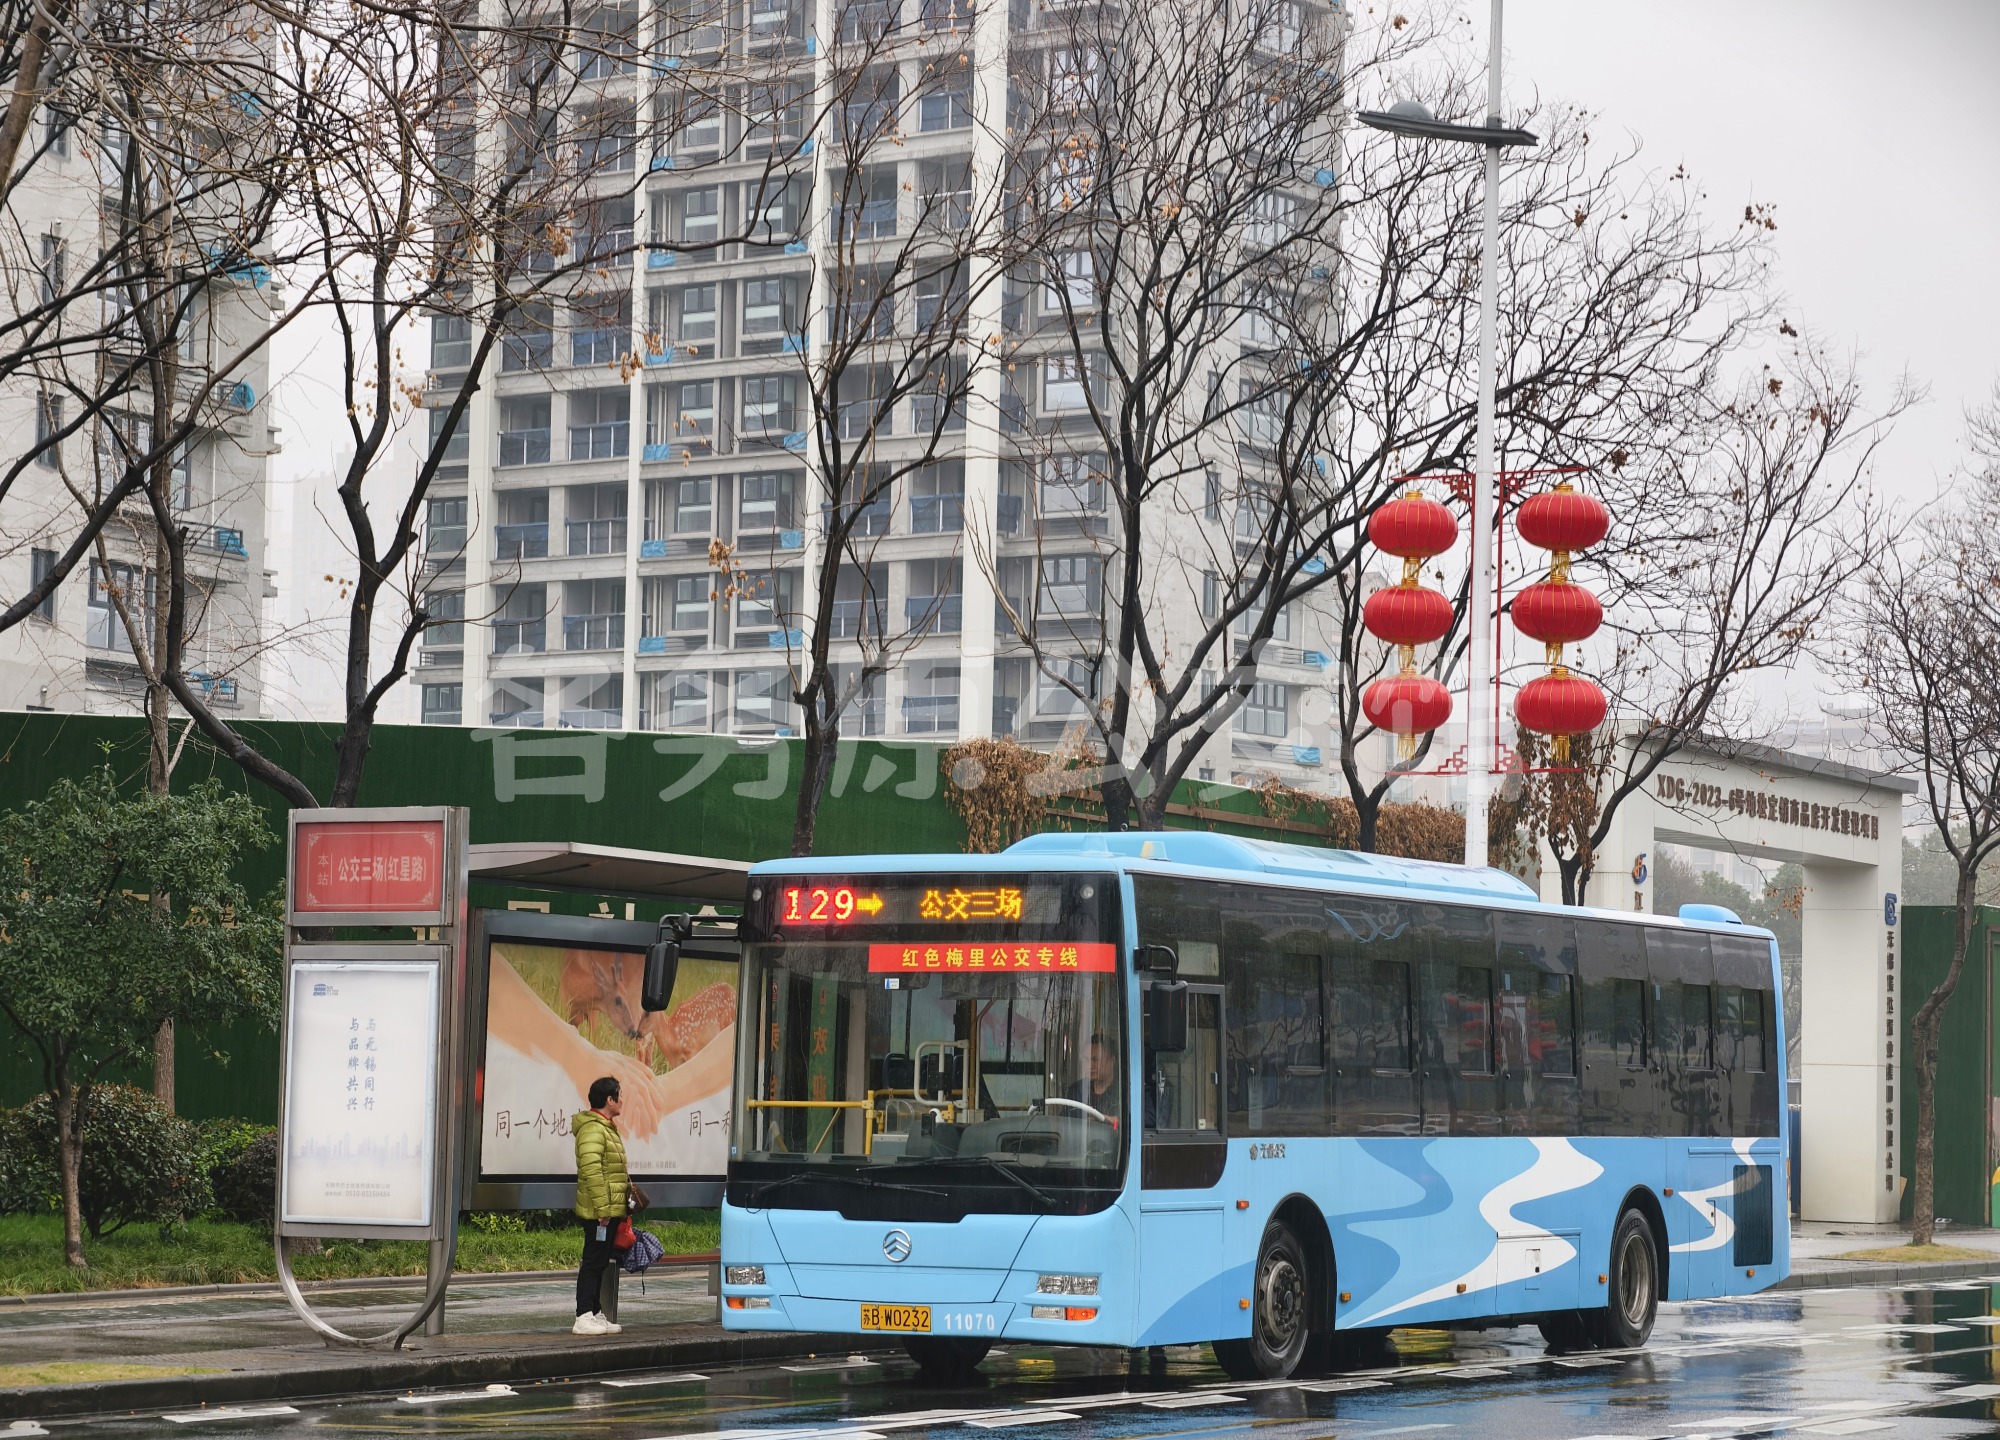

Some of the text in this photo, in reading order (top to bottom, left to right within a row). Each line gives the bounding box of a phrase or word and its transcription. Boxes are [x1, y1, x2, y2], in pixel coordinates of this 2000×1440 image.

[316, 852, 329, 886] 本站
[338, 855, 427, 883] 公交三场(红星路)
[785, 888, 854, 921] 129
[920, 888, 1023, 920] 公交三场
[902, 946, 1079, 968] 红色梅里公交专线
[346, 1017, 360, 1111] 与品牌共兴
[495, 1108, 582, 1140] 同一个地
[943, 1312, 996, 1331] 11070
